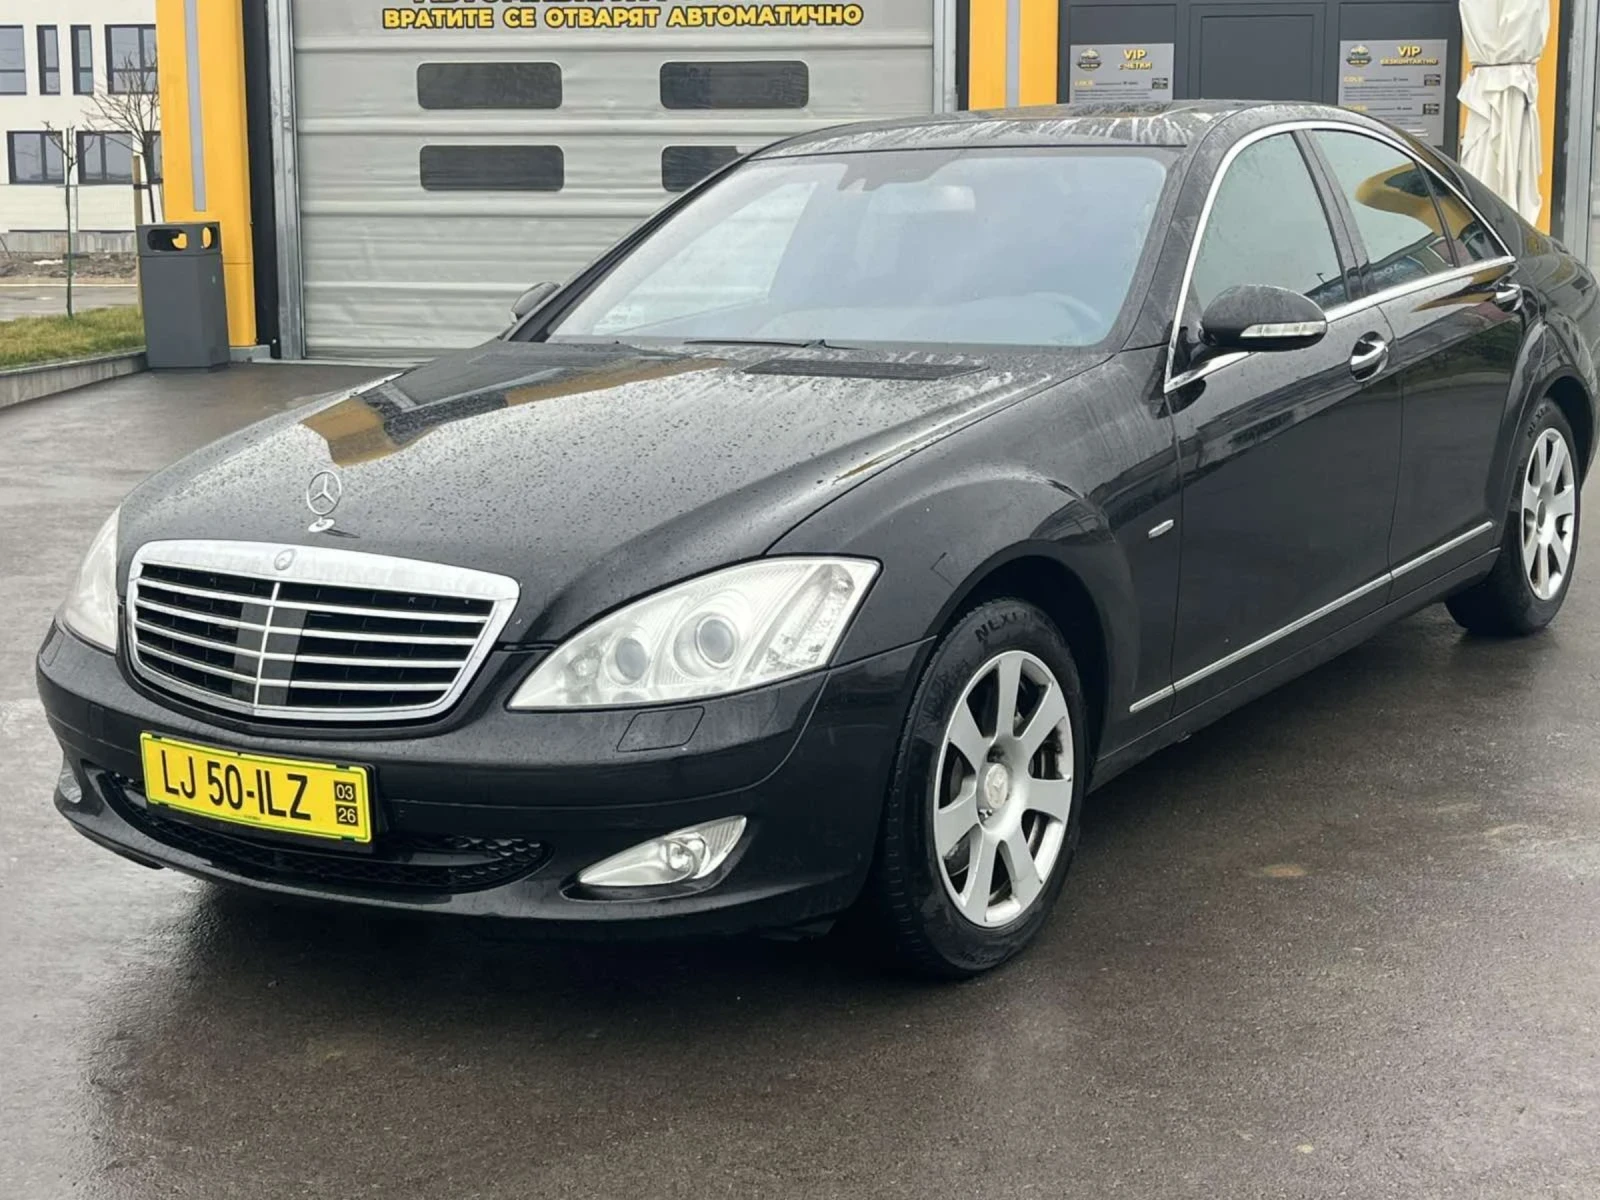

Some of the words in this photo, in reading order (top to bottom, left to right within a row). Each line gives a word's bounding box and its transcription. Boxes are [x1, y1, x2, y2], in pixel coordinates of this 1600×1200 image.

[383, 8, 494, 29] ВРАТИТЕ
[503, 7, 536, 28] СЕ
[544, 7, 660, 28] ОТВАРЯТ
[666, 5, 864, 27] АВТОМАТИЧНО
[1123, 48, 1147, 61] VIP
[1396, 46, 1422, 57] VIP
[161, 750, 196, 799] LJ
[207, 760, 312, 821] 50-ILZ
[336, 783, 355, 801] 03
[338, 806, 357, 824] 26
